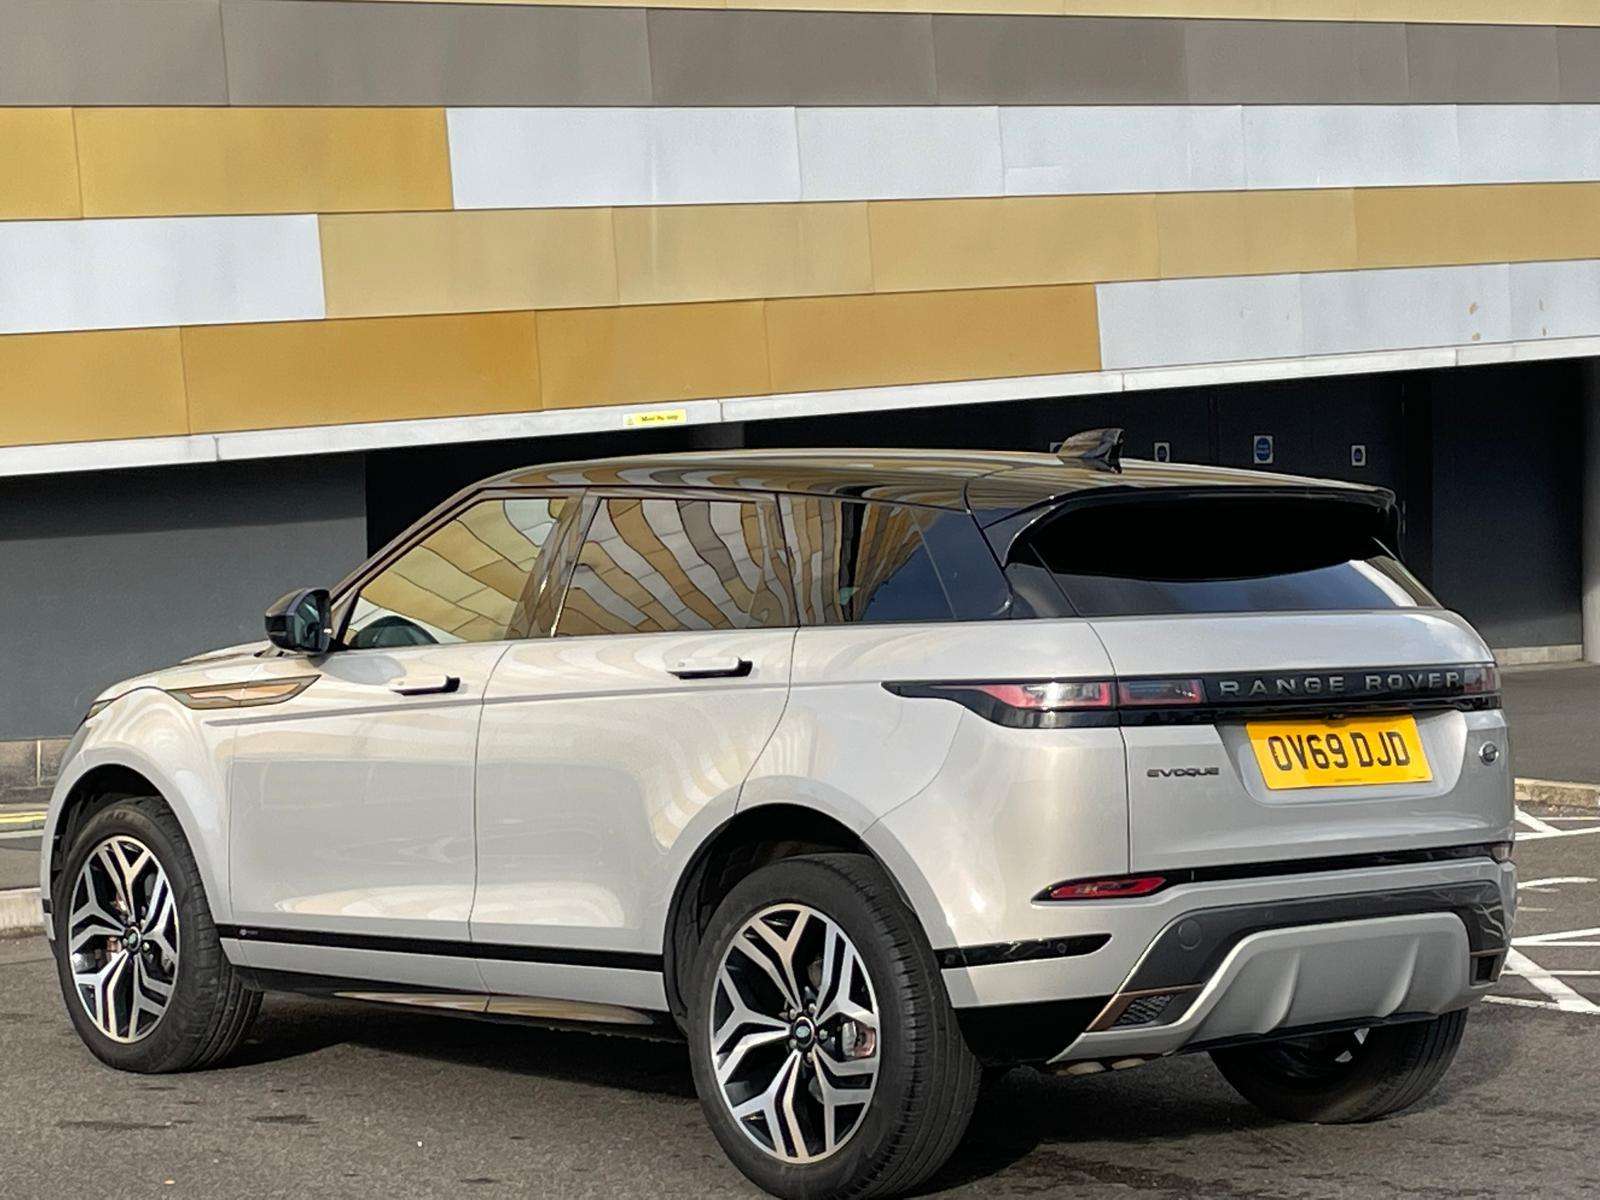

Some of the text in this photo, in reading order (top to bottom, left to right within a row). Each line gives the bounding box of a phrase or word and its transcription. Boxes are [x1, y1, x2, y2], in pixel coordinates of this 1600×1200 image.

[1219, 671, 1459, 696] RANGE ROVER
[1268, 731, 1411, 771] OV69 DJD
[1147, 767, 1219, 778] EVOQUE
